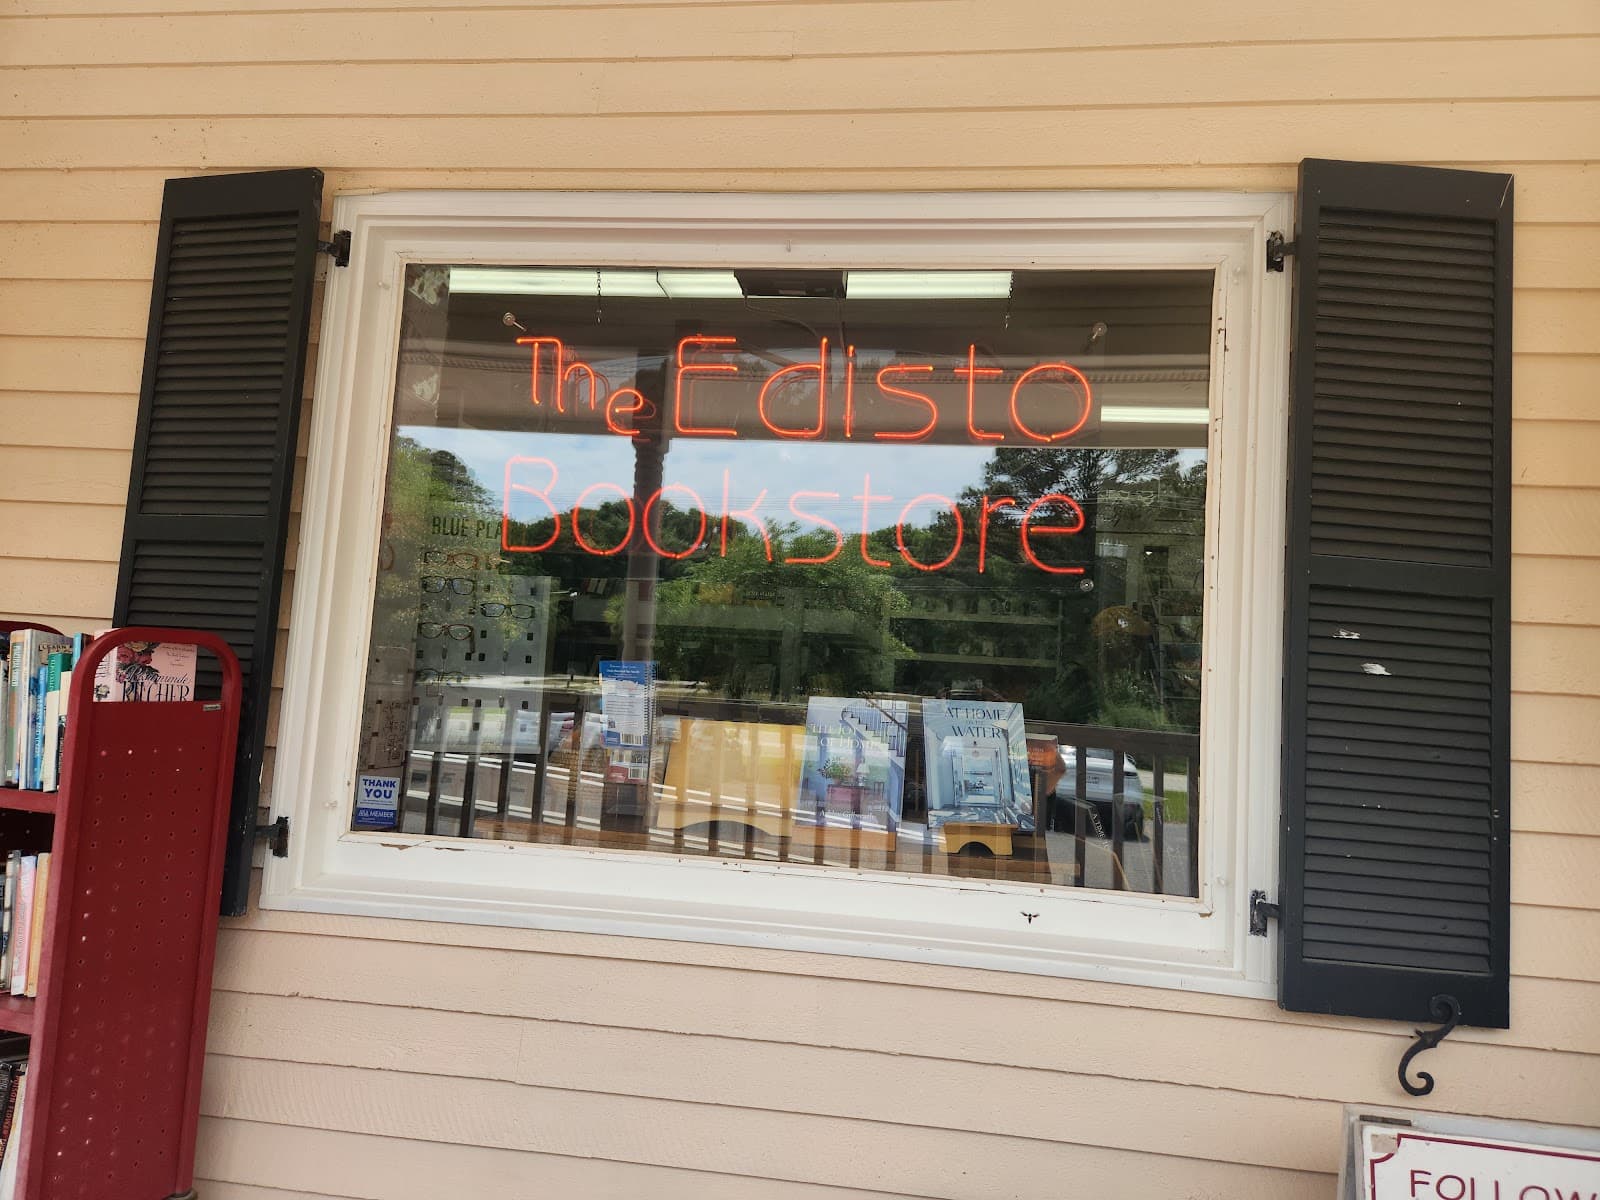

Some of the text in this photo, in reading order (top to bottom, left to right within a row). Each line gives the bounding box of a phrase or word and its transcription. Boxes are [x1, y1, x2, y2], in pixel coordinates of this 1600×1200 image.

[515, 332, 1094, 442] The Edisto
[500, 454, 1087, 575] Bookstore
[431, 515, 470, 537] BLUE
[944, 706, 963, 720] AT
[964, 708, 1008, 722] HOME
[951, 725, 1003, 739] WATER
[362, 778, 397, 788] THANK
[364, 788, 393, 799] YOU
[369, 810, 395, 818] MEMBER
